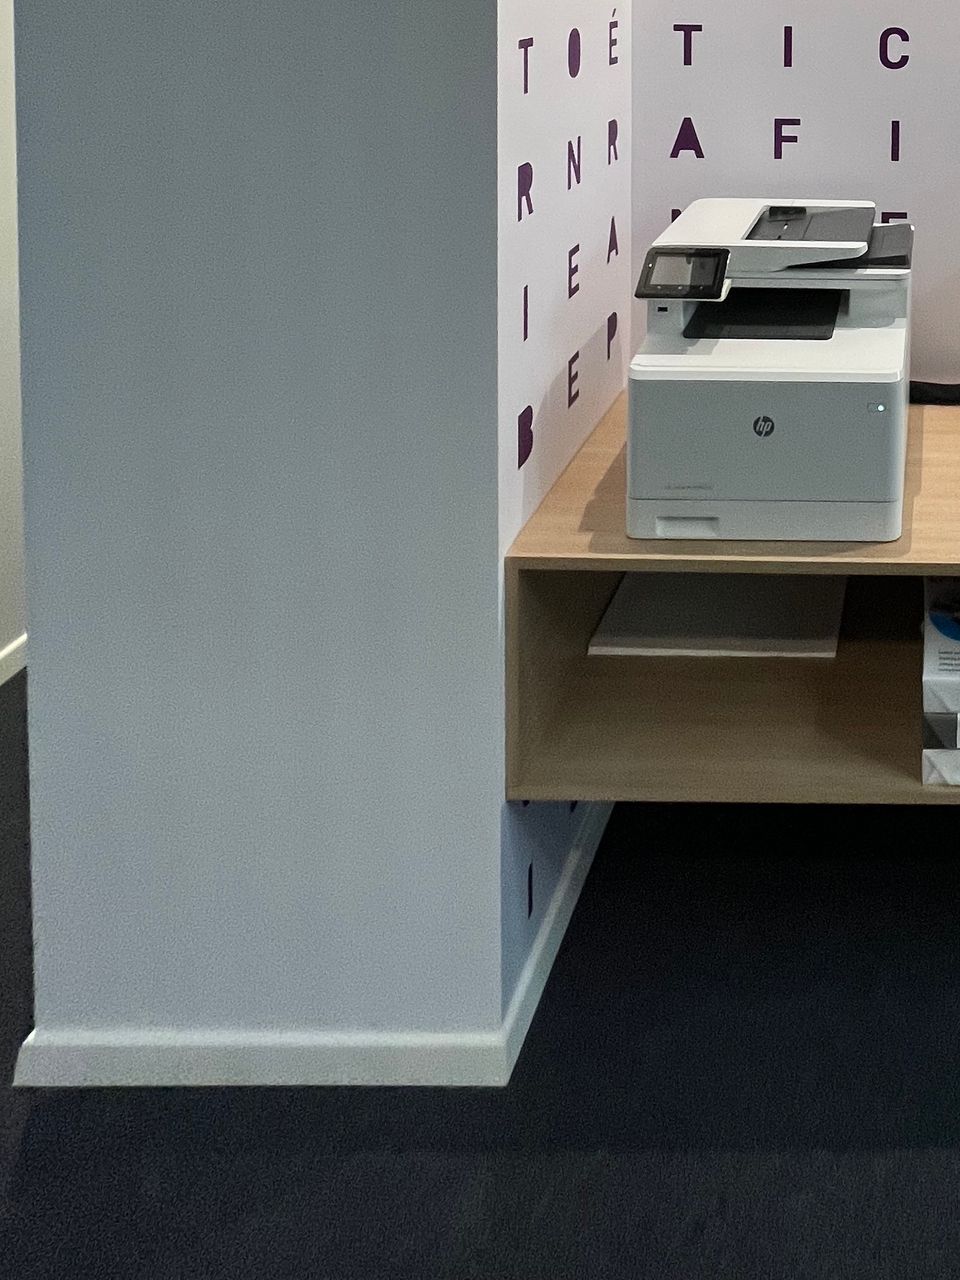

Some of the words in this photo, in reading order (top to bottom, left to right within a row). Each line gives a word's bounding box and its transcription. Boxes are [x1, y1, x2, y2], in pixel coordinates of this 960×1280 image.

[517, 36, 534, 95] T
[608, 8, 620, 66] É
[672, 23, 703, 67] T
[878, 26, 910, 70] C
[517, 161, 535, 223] R
[567, 135, 582, 191] N
[607, 118, 619, 166] R
[669, 116, 705, 159] A
[773, 117, 802, 160] F
[567, 243, 580, 300] E
[606, 215, 619, 265] A
[567, 350, 580, 410] E
